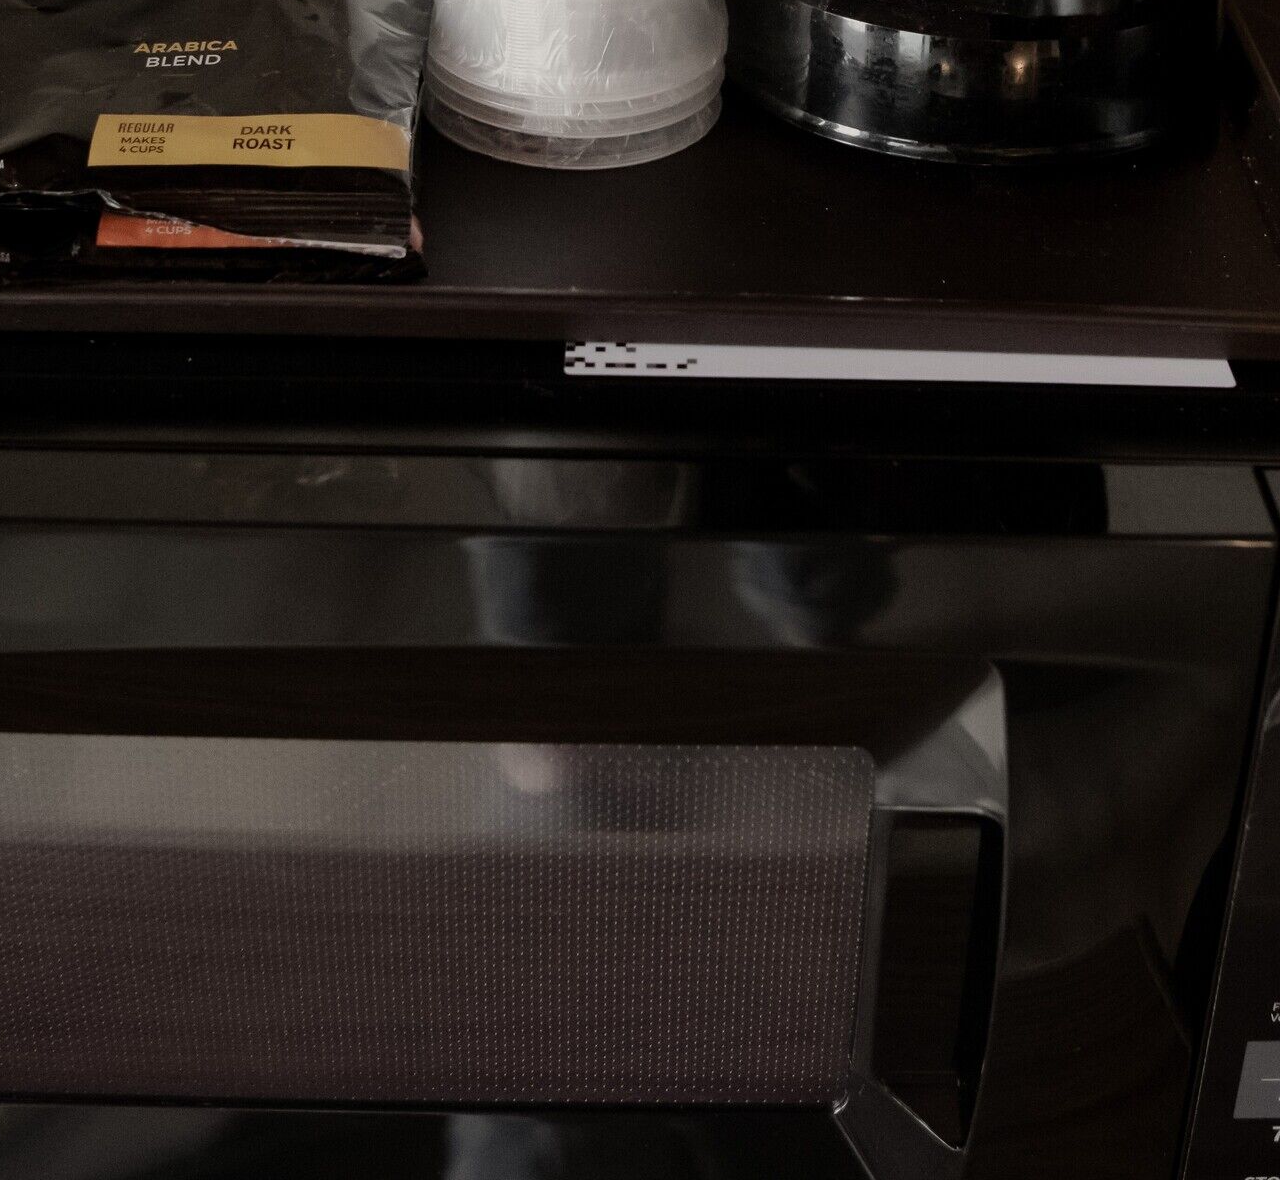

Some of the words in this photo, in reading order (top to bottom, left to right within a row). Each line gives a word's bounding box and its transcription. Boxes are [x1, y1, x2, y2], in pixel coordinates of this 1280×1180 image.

[133, 40, 238, 54] ARABICA
[145, 54, 222, 68] BLEND
[118, 123, 175, 134] REGULAR
[240, 125, 293, 135] DARK
[121, 136, 166, 144] MAKES
[232, 138, 296, 150] ROAST
[119, 146, 127, 154] 4
[129, 145, 164, 154] CUPS
[158, 226, 193, 235] CUPS
